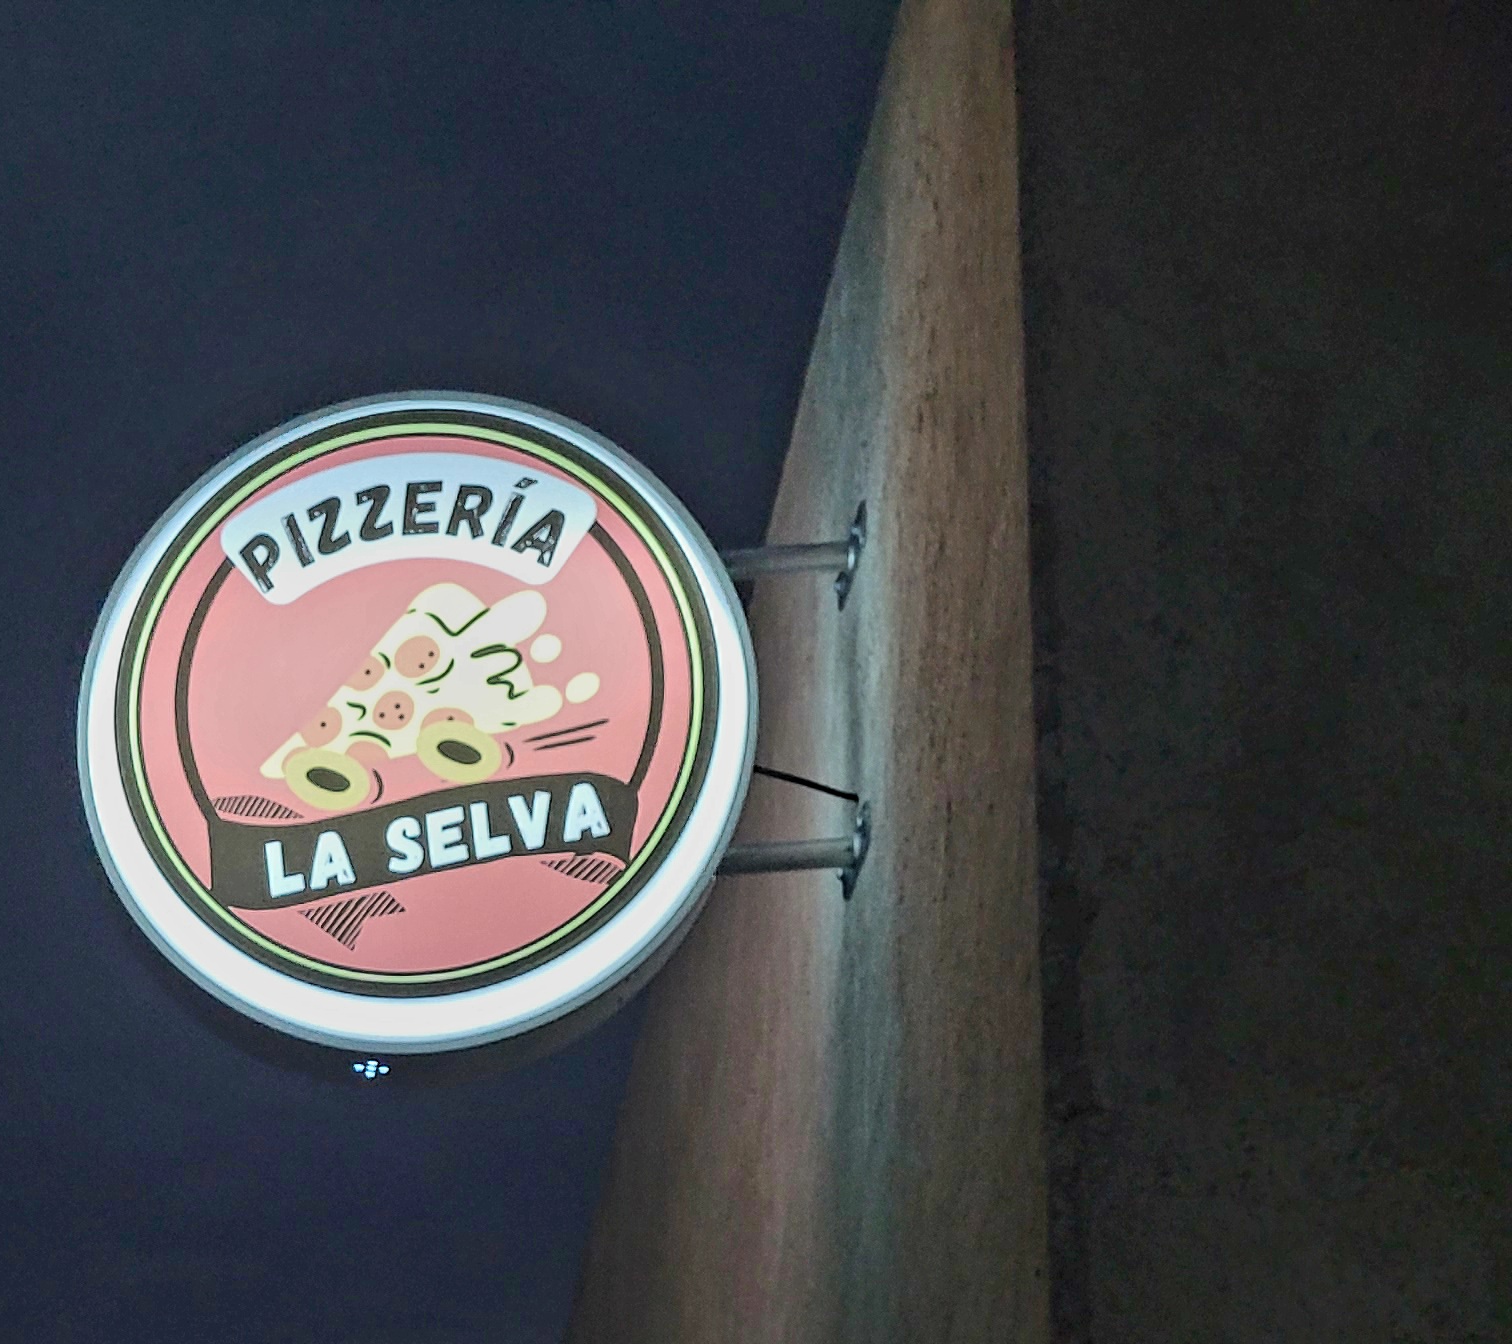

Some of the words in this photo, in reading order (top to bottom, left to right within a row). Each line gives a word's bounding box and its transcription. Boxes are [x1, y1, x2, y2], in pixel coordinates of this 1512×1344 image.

[238, 478, 568, 594] PIZZERÍA
[264, 830, 355, 899] LA
[386, 783, 611, 875] SELVA
